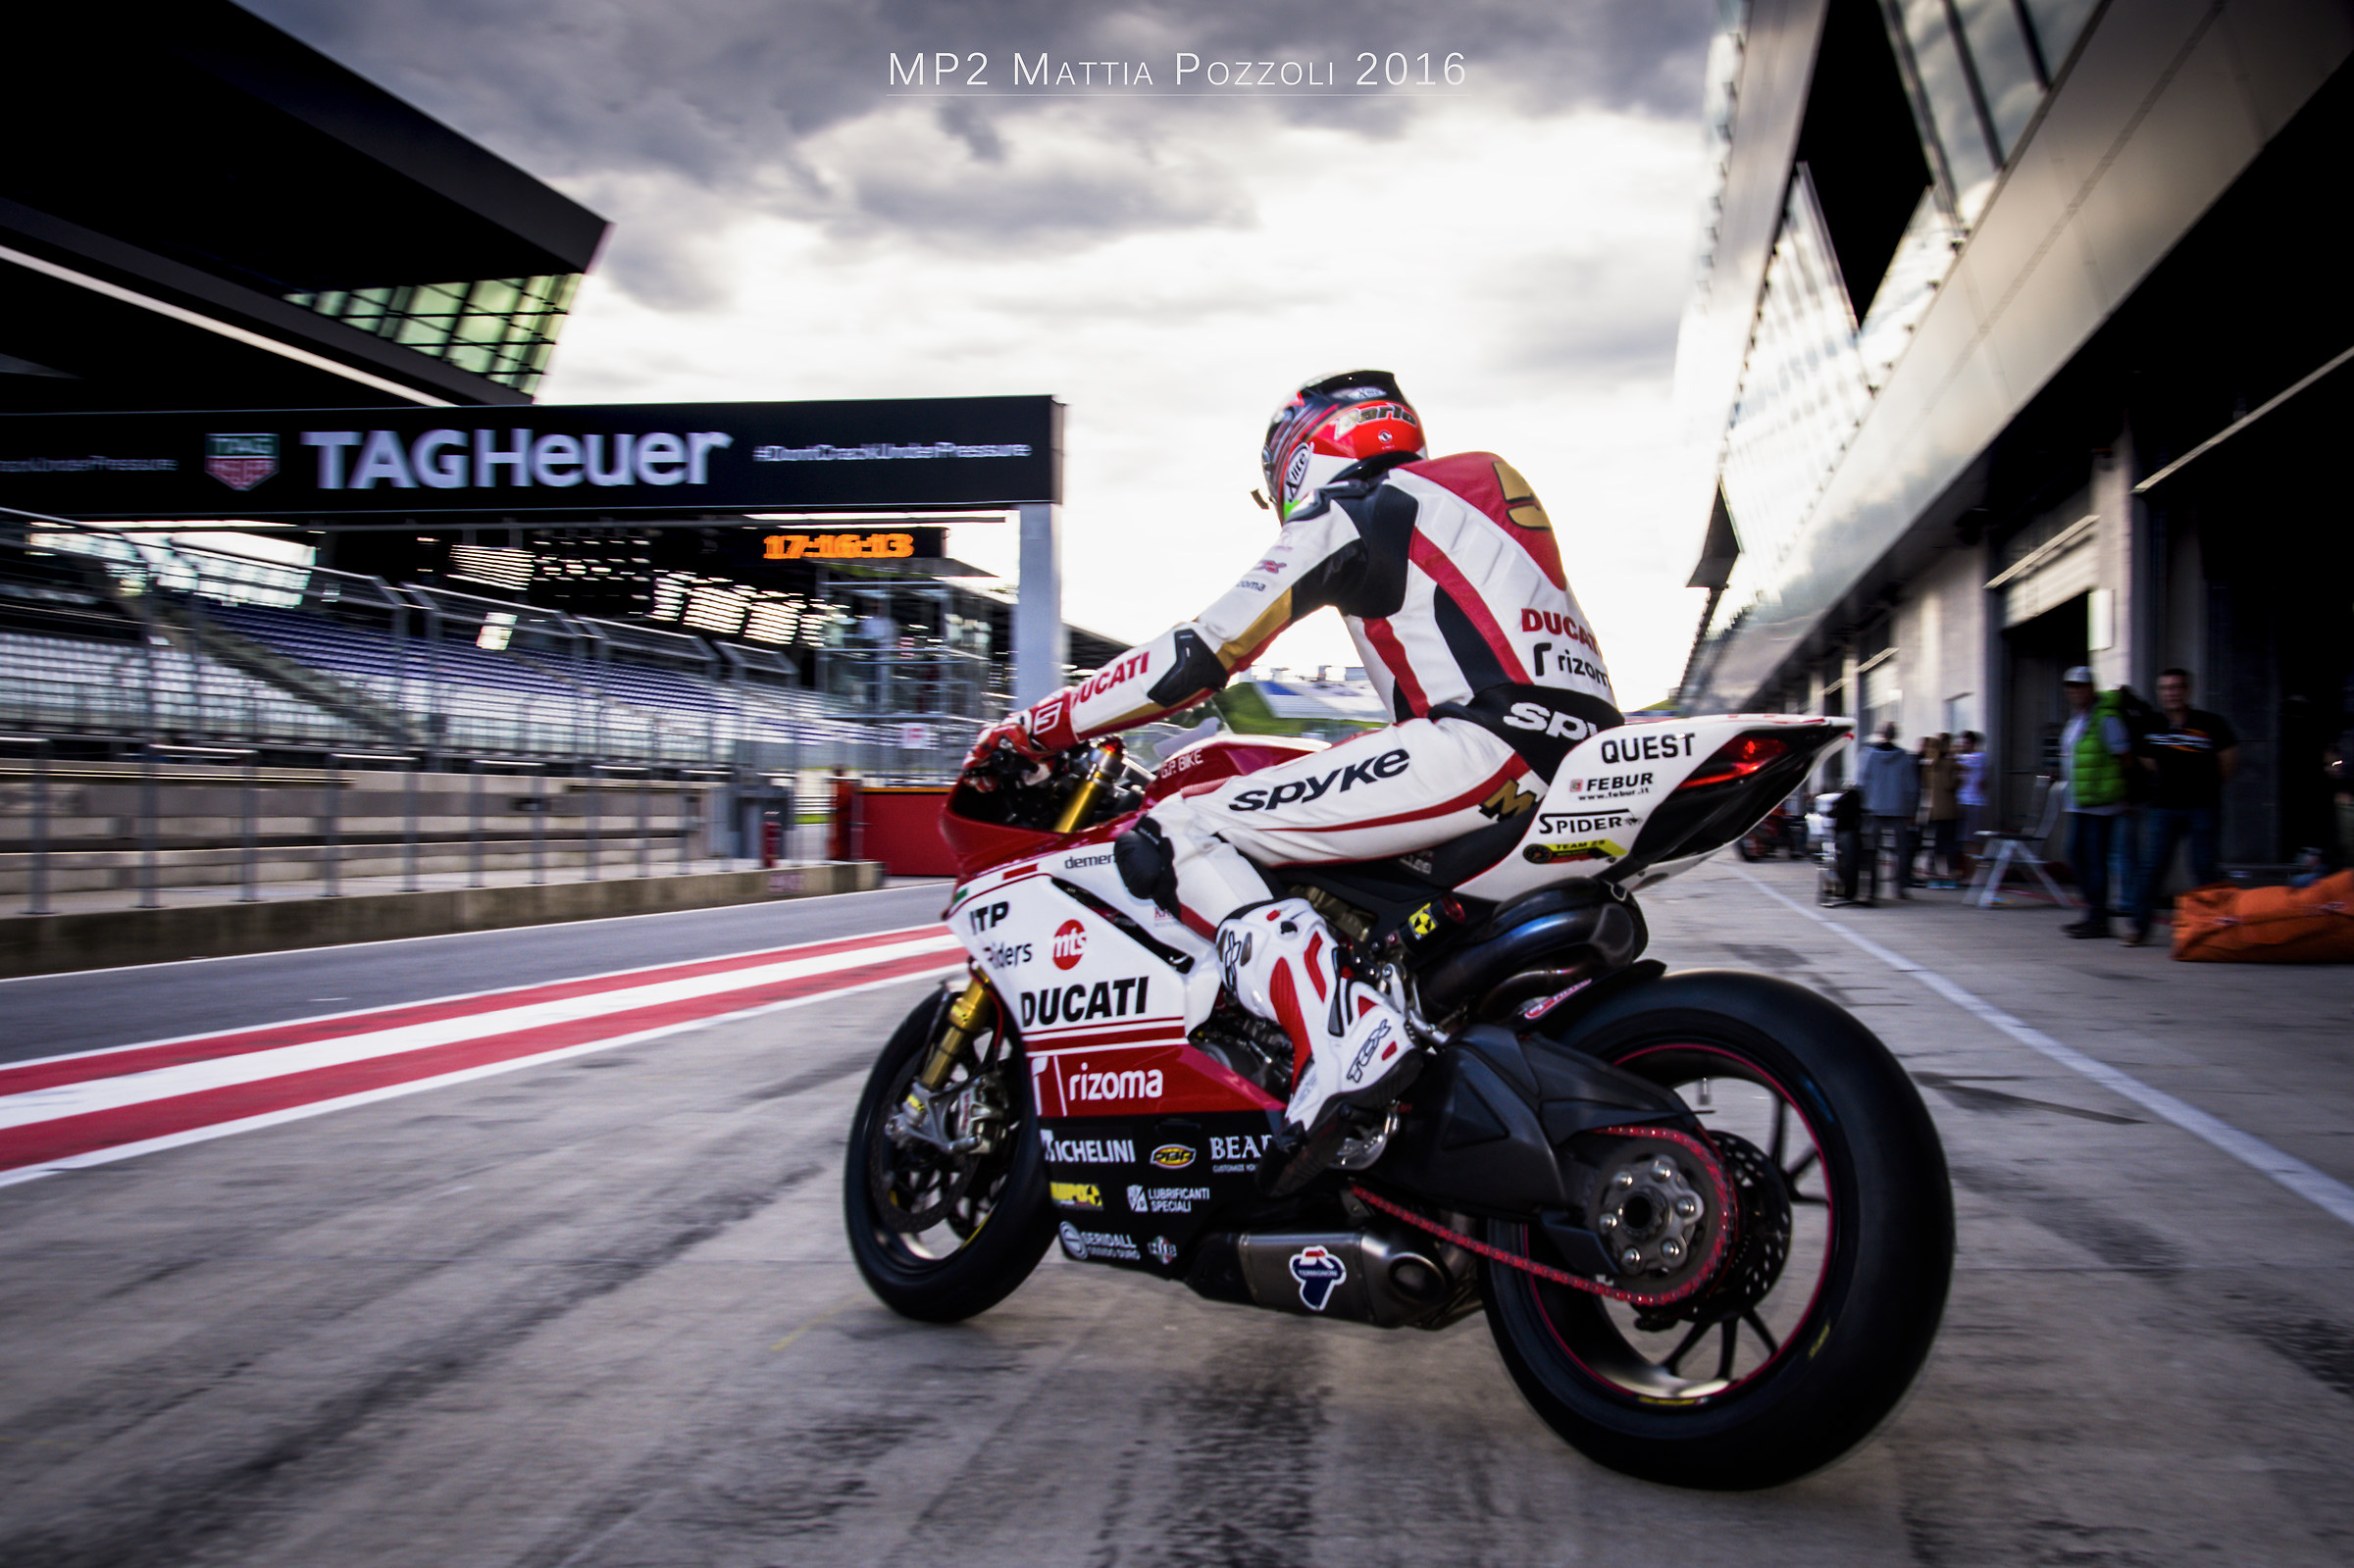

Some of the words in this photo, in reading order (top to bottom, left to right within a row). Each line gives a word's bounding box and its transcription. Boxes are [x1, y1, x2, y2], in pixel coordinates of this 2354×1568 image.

[1558, 648, 1610, 689] rizom
[1601, 733, 1696, 764] QUEST
[1586, 772, 1653, 791] FEBUR
[1020, 975, 1151, 1028] DUCATI
[1068, 1062, 1163, 1101] rizoma
[1148, 1187, 1210, 1200] LUBRIFICANTI
[1151, 1199, 1192, 1213] SPECIALI
